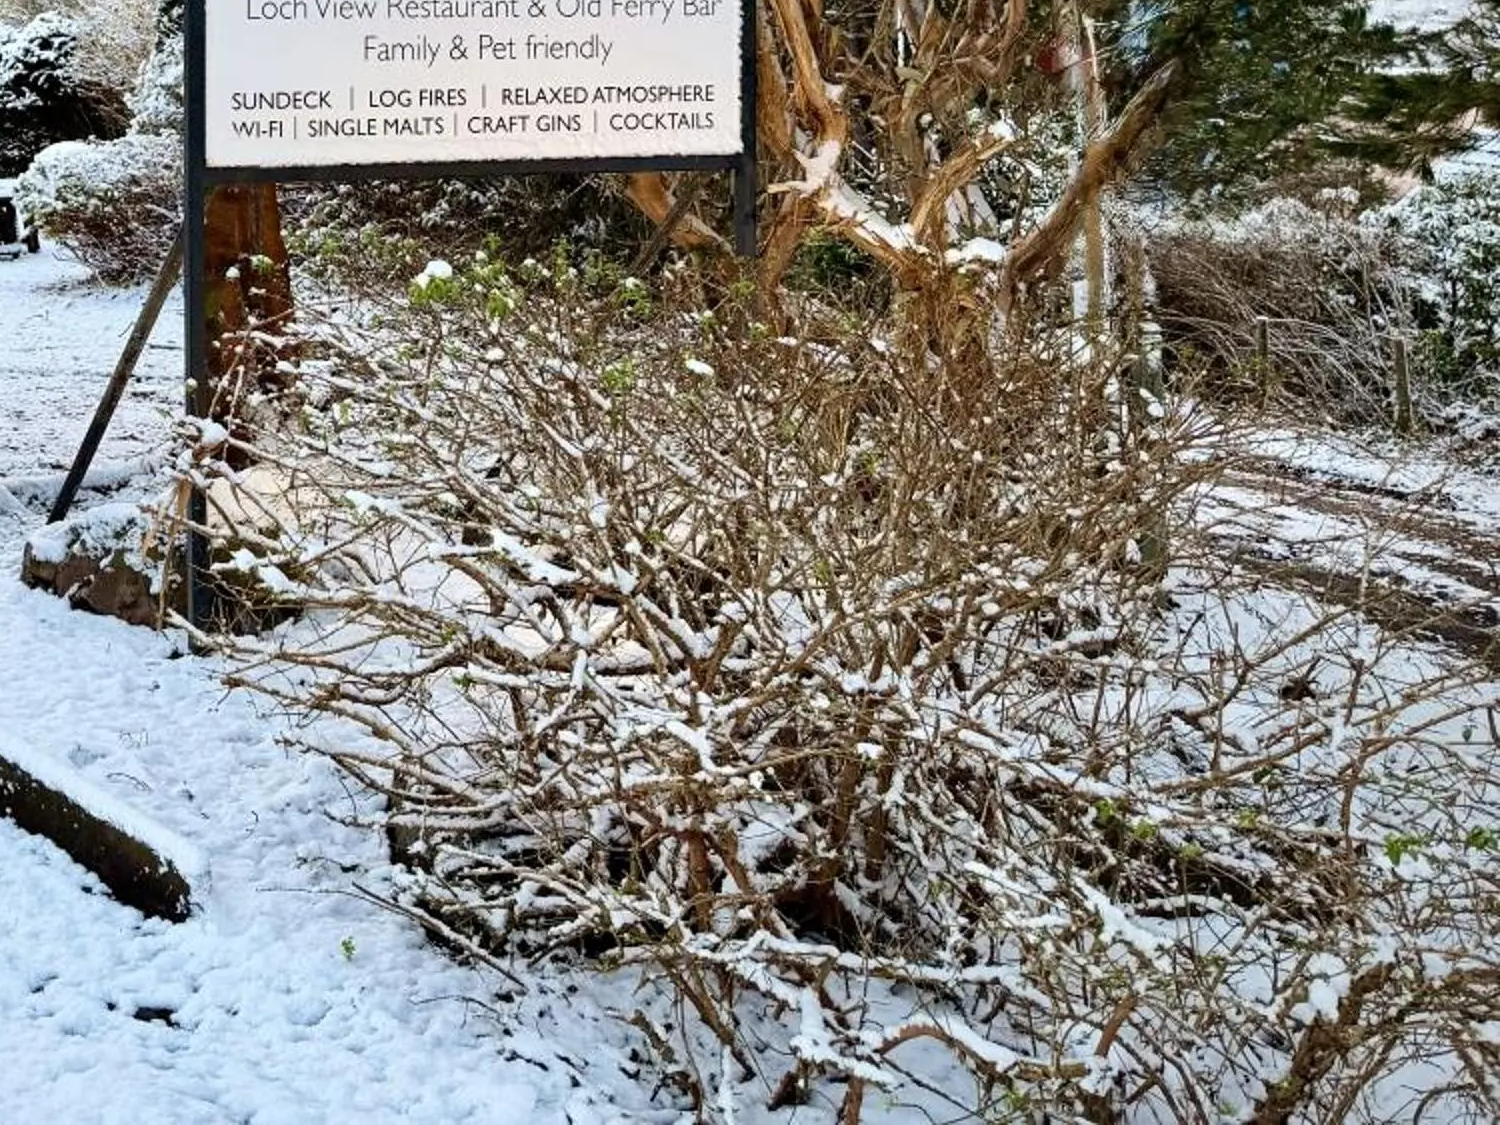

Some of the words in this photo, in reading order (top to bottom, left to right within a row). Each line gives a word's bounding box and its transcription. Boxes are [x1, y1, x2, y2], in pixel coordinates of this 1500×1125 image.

[363, 35, 440, 68] Family
[449, 34, 468, 60] &
[479, 34, 516, 60] Pet
[525, 34, 613, 65] friendly
[231, 90, 332, 110] SUNDECK
[369, 90, 412, 108] LOG
[419, 88, 467, 107] FIRES
[502, 87, 589, 106] RELAXED
[592, 85, 715, 103] ATMOSPHERE
[232, 121, 283, 138] WI-FI
[307, 118, 377, 137] SINGLE
[383, 117, 445, 136] MALTS
[467, 115, 530, 134] CRAFT
[536, 114, 582, 132] GINS
[609, 112, 714, 131] COCKTAILS
